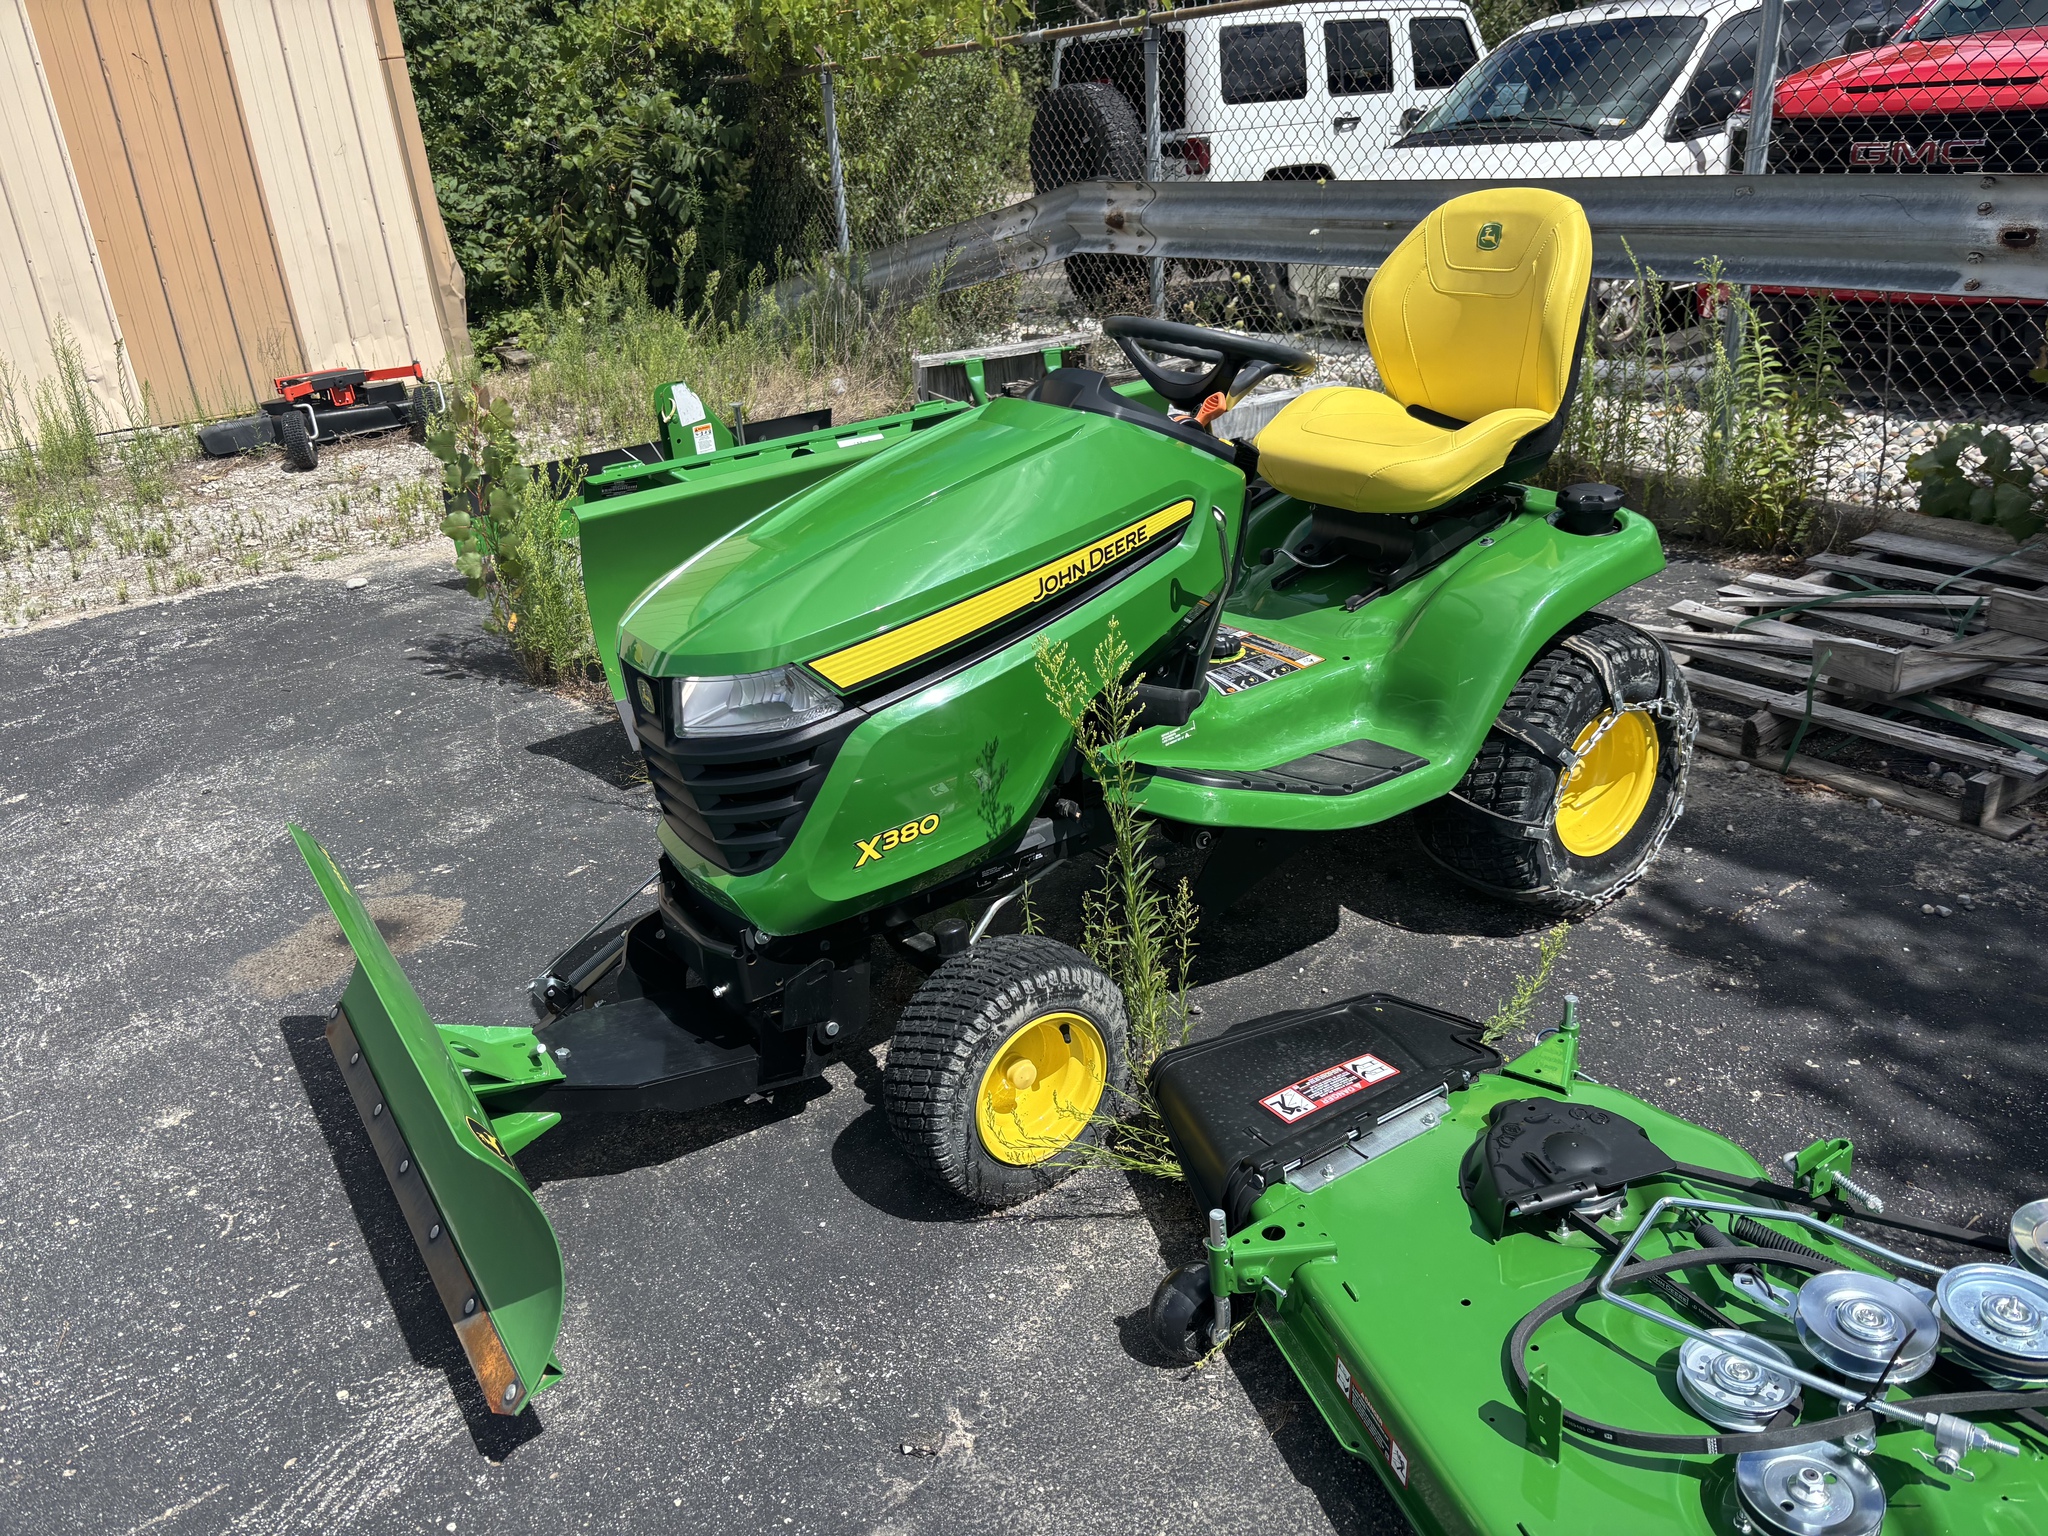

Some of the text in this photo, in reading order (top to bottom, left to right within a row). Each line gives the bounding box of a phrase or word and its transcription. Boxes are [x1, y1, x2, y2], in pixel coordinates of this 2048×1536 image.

[1850, 139, 1987, 165] GMC
[1033, 525, 1148, 601] JOHN DEERE
[853, 813, 940, 869] X380
[1321, 1084, 1355, 1104] DANGER
